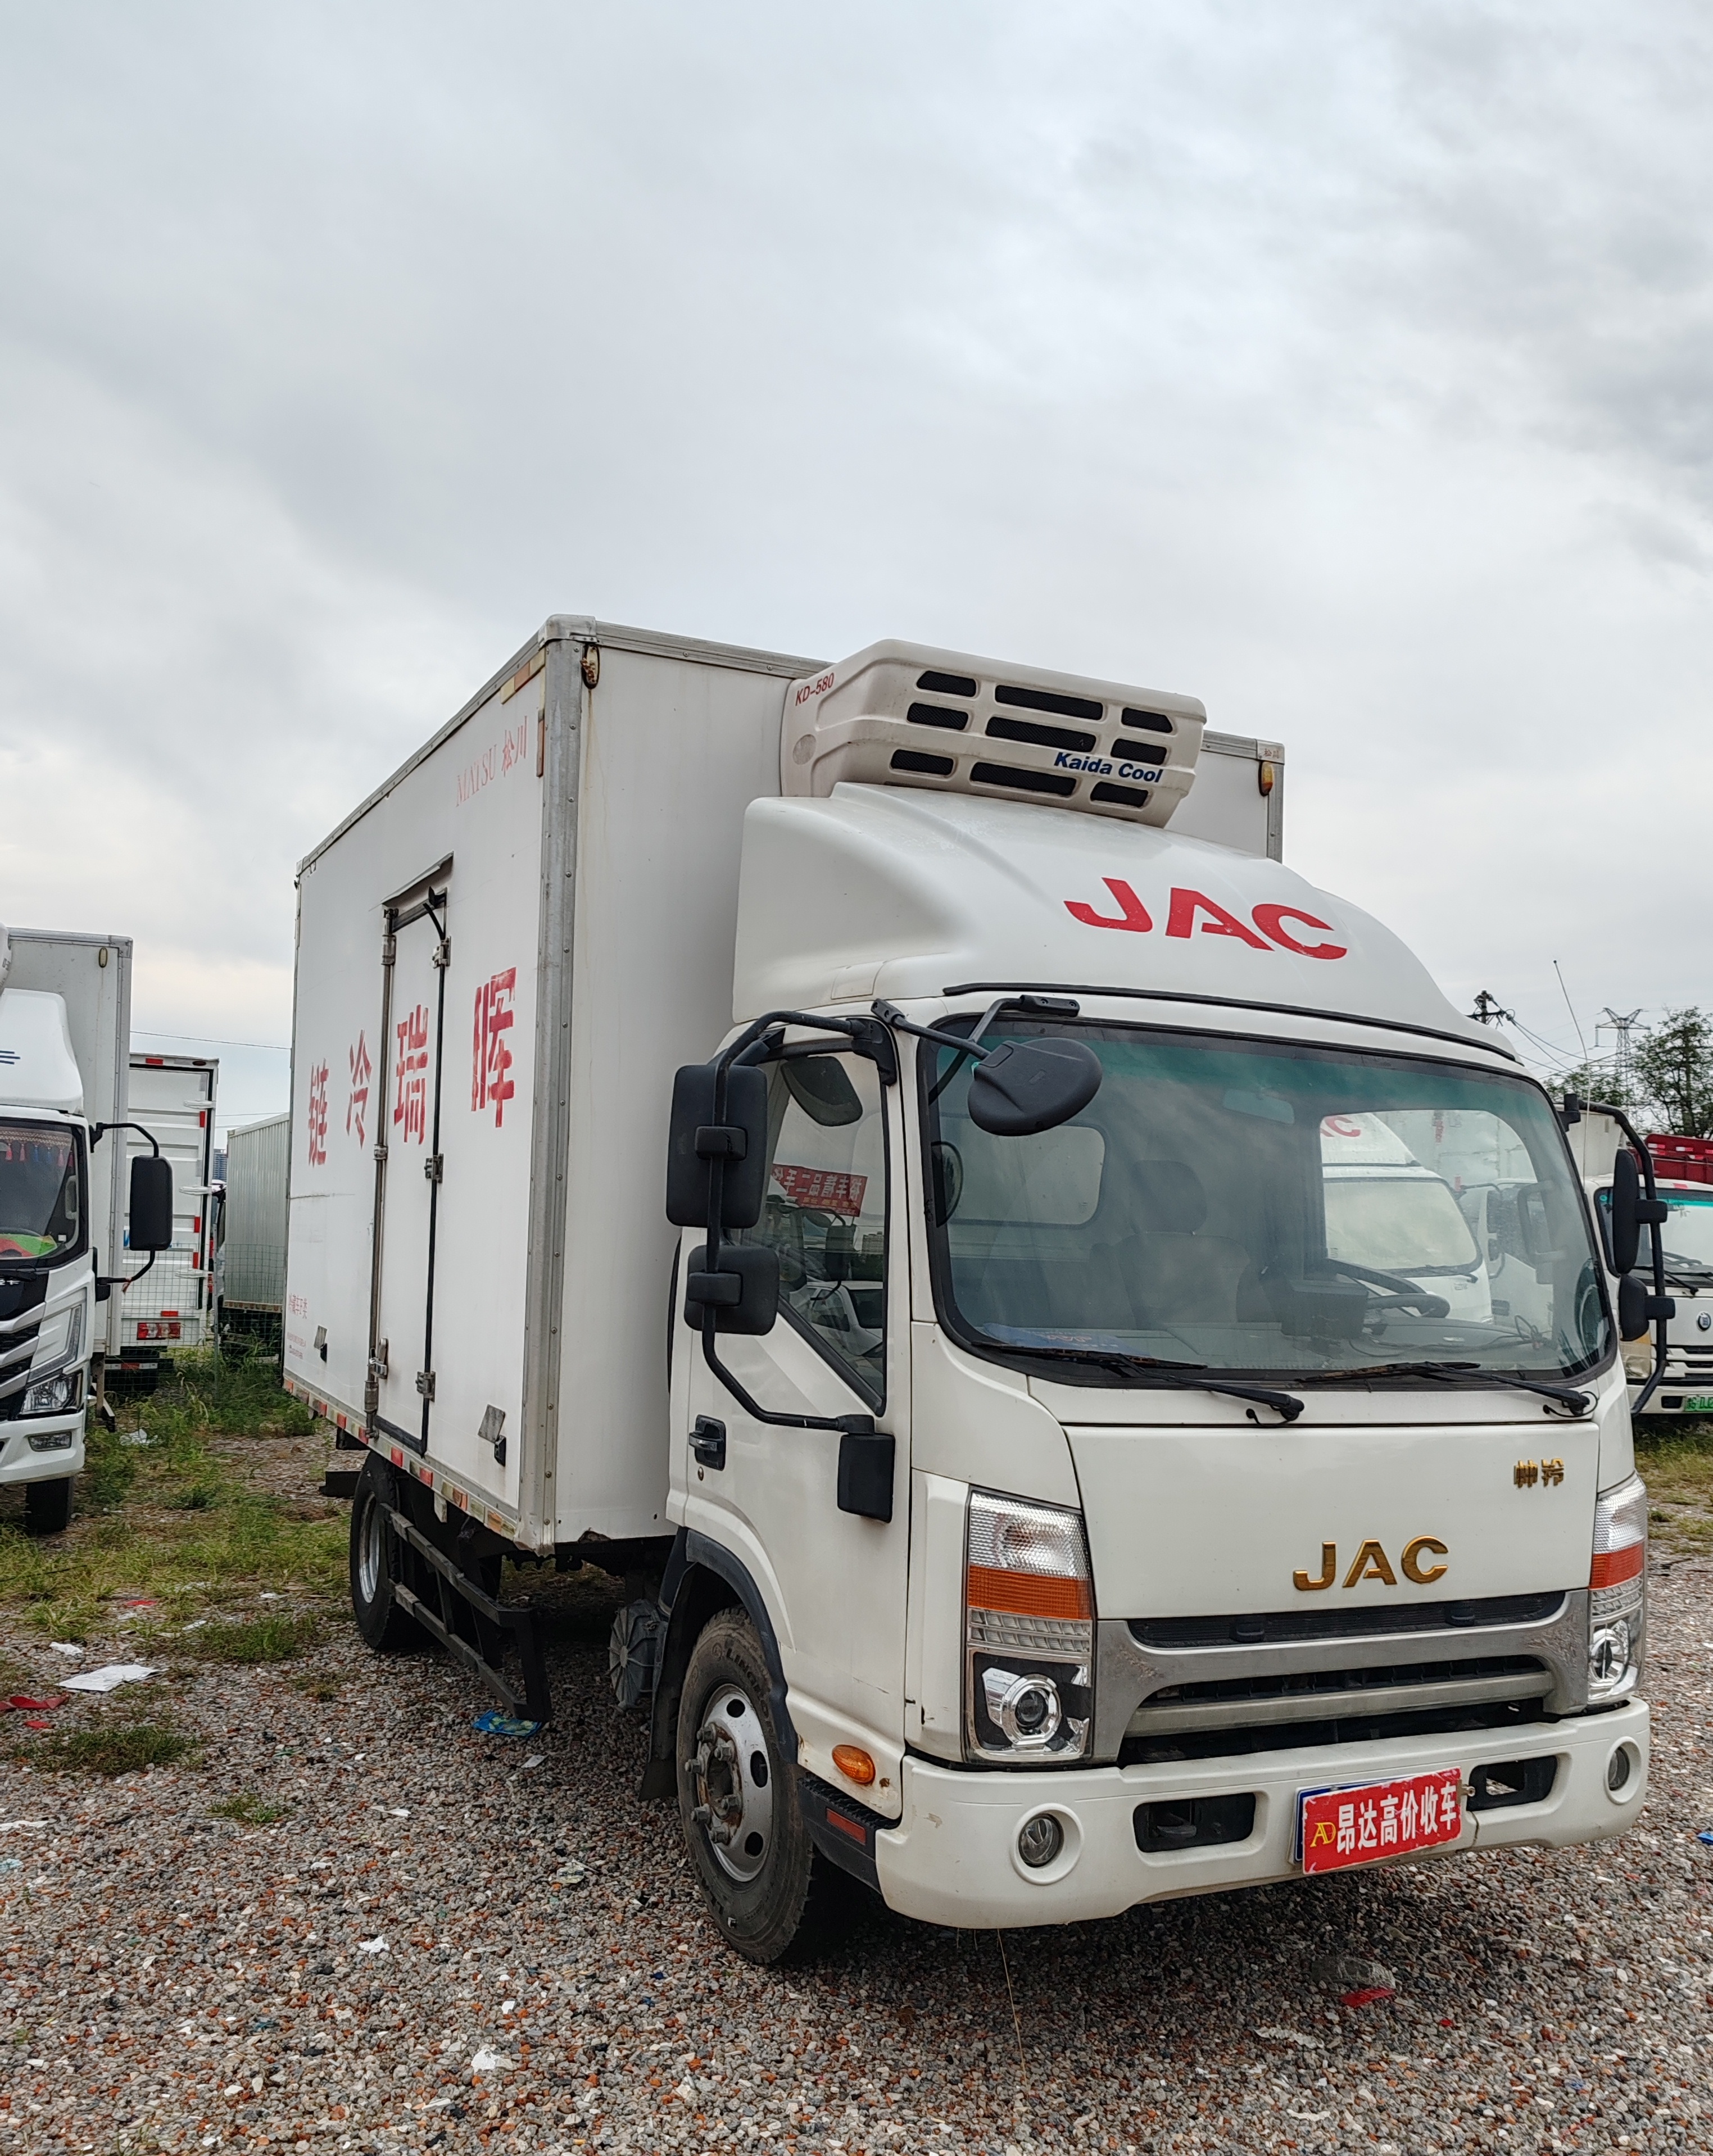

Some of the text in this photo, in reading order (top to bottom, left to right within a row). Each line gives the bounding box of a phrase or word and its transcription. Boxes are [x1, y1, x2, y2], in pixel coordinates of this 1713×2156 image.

[795, 671, 835, 707] KD-580
[501, 715, 528, 777] 松川
[1054, 752, 1164, 783] Kaida Cool
[1063, 877, 1348, 960] JAC
[1293, 1535, 1448, 1591] JAC
[1336, 1781, 1457, 1855] 昂达高价收车
